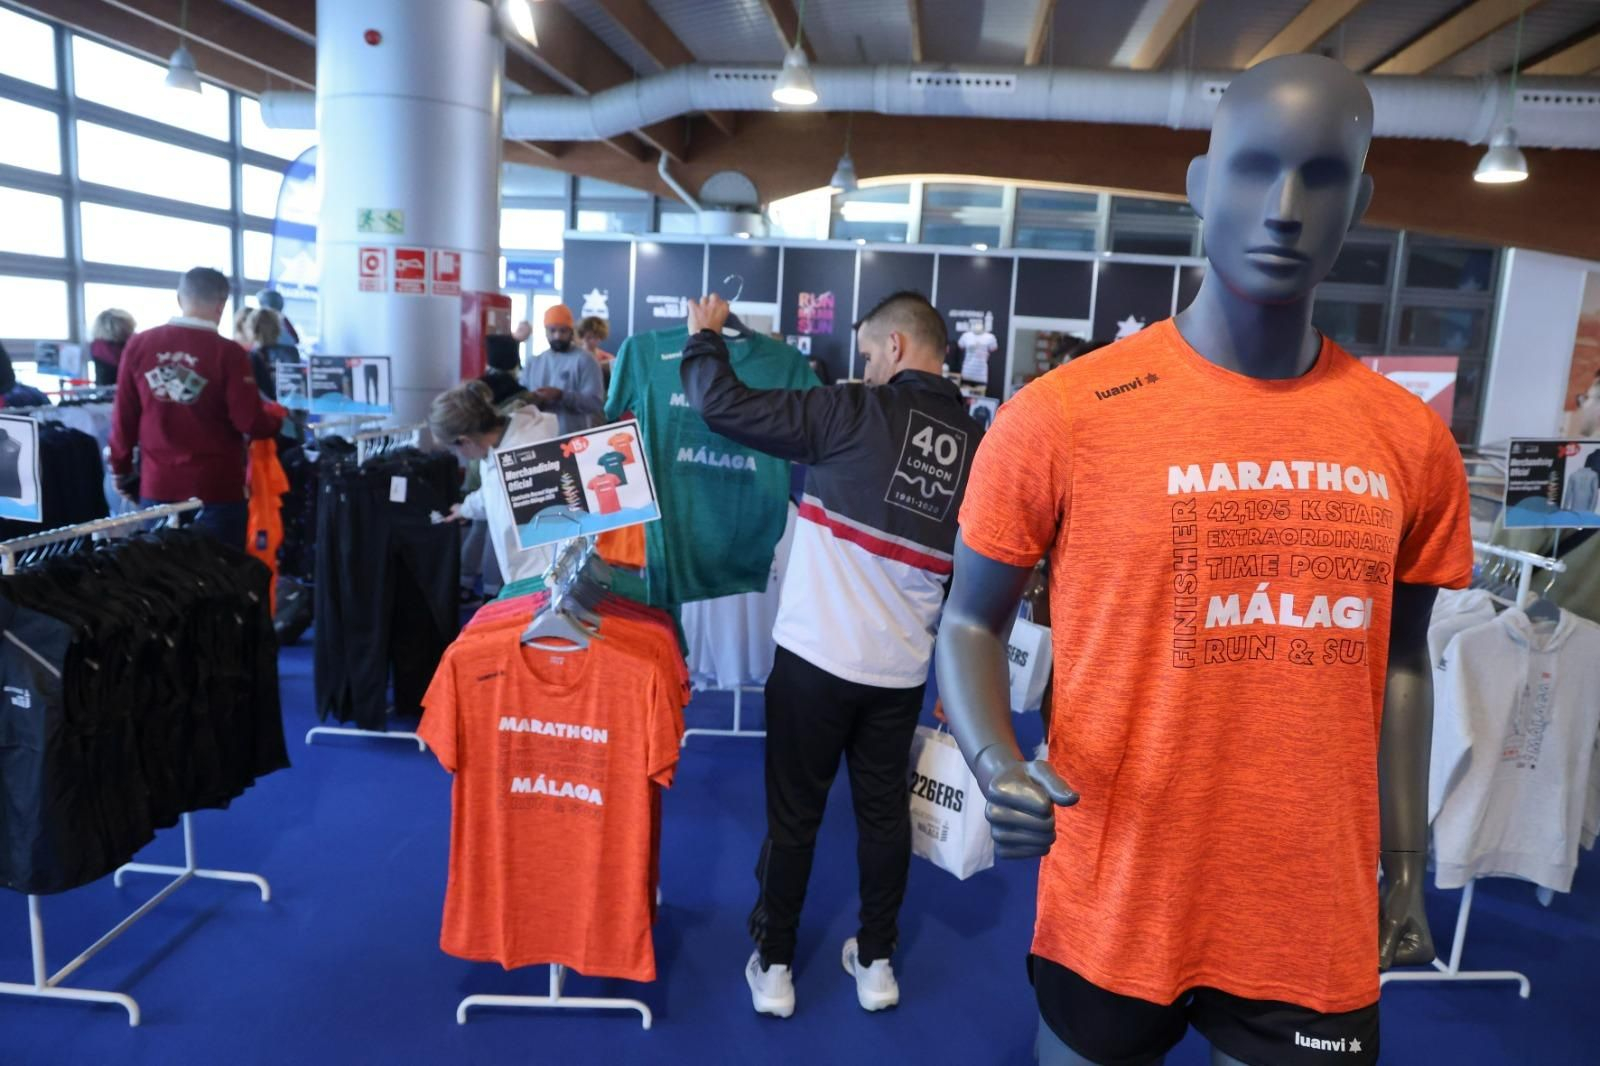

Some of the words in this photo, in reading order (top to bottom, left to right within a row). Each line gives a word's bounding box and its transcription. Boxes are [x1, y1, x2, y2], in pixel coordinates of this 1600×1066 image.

[1095, 377, 1143, 400] luanvi
[676, 446, 757, 471] MÁLAGA
[912, 425, 958, 466] 40
[906, 456, 952, 481] LONDON
[1167, 460, 1390, 500] MARATHON
[1207, 500, 1291, 525] 42,195
[1301, 500, 1321, 521] K
[1325, 500, 1394, 530] START
[1207, 527, 1396, 554] EXTRAORDINARY
[1172, 497, 1198, 669] FINISHER
[1206, 555, 1280, 580] TIME
[1290, 554, 1392, 585] POWER
[1204, 635, 1276, 665] RUN
[1288, 638, 1314, 666] &
[1322, 638, 1368, 667] SU
[499, 717, 609, 744] MARATHON
[511, 773, 604, 806] MÁLAGA
[910, 771, 964, 813] 226ERS
[1295, 1031, 1346, 1052] luanvi
